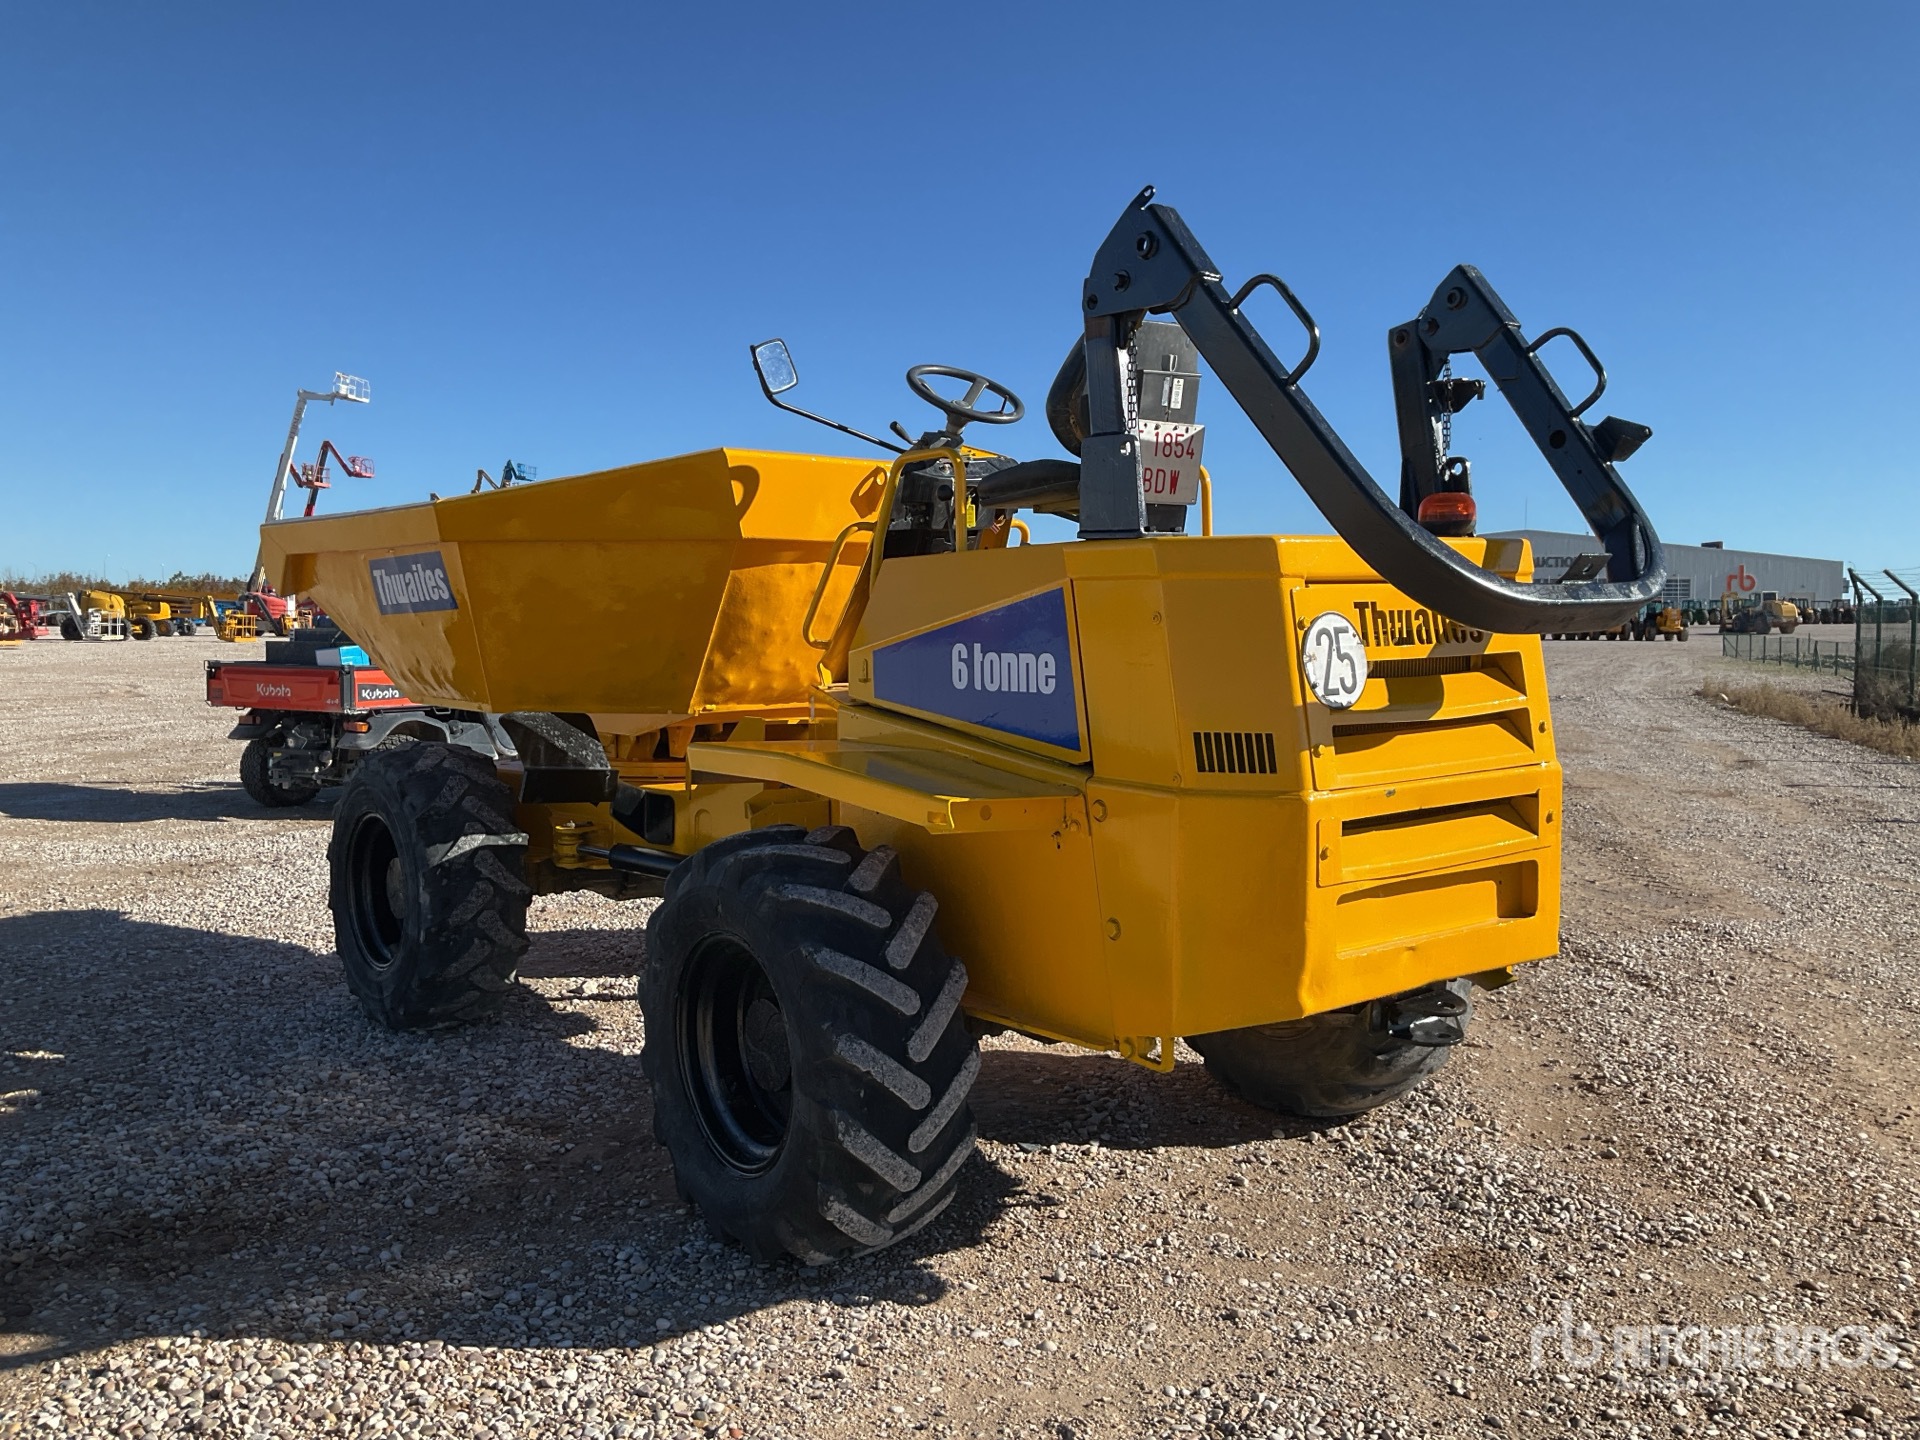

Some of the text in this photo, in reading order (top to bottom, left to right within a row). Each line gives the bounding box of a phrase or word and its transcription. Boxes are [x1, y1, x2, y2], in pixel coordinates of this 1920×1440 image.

[1154, 431, 1195, 460] 1854
[1143, 467, 1180, 495] BDW
[372, 563, 450, 606] Thwaites
[1726, 564, 1756, 592] rb
[951, 642, 1057, 695] 6 tonne
[1315, 625, 1358, 696] 25
[256, 683, 291, 697] Kubota
[361, 687, 400, 700] Kubota
